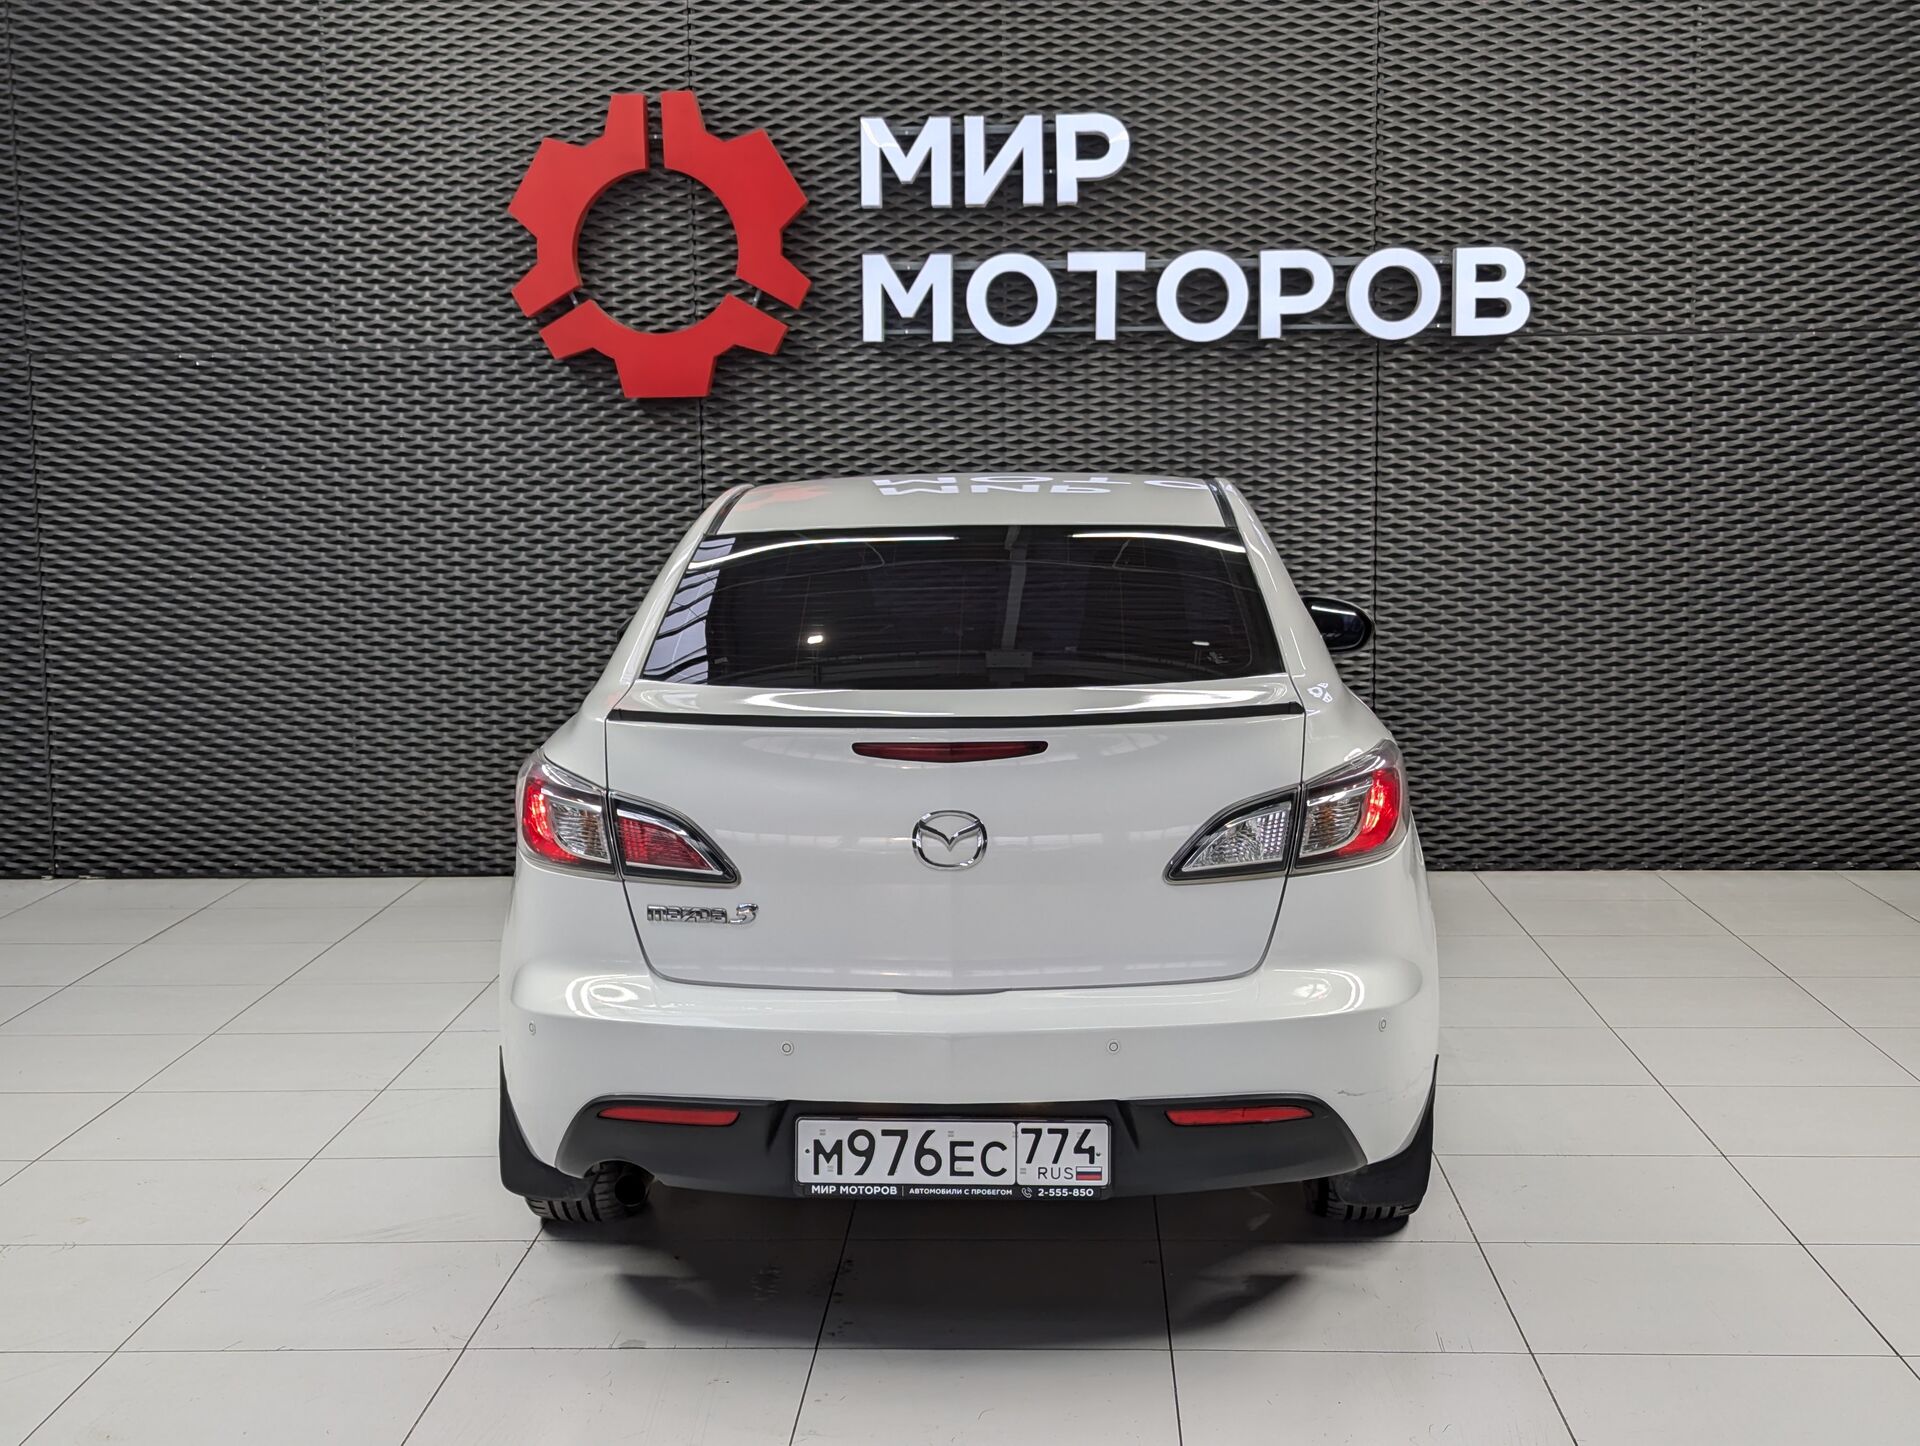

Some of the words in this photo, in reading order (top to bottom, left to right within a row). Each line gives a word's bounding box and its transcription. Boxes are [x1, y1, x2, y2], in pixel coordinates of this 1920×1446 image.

[860, 113, 1130, 208] МИР
[861, 247, 1531, 345] МОТОРОВ
[1020, 1128, 1096, 1165] 774
[811, 1185, 837, 1194] МИР
[839, 1185, 898, 1195] МОТОРОВ
[908, 1187, 963, 1195] АВТОМОБИЛИ
[971, 1188, 1013, 1196] ПРОБЕГОМ
[1037, 1188, 1095, 1197] 2-555-850
[1037, 1166, 1074, 1180] RUS
